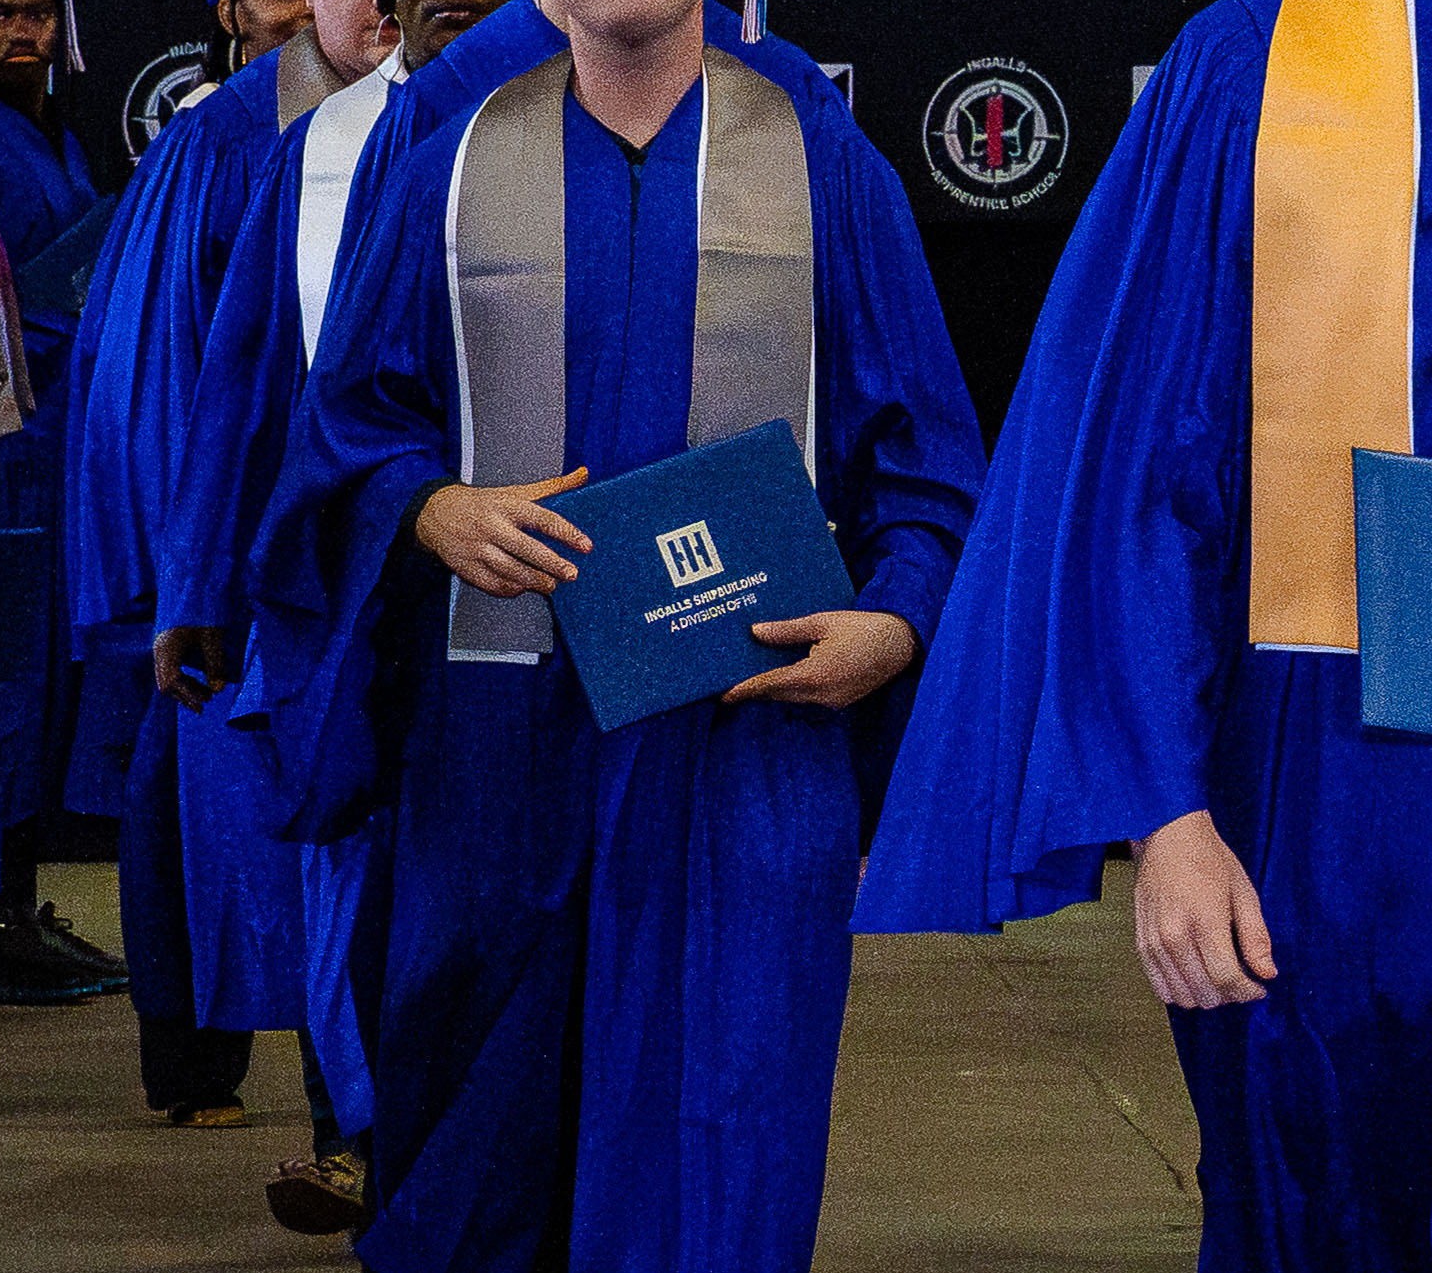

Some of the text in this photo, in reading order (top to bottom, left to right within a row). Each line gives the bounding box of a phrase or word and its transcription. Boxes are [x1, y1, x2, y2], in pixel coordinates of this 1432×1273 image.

[644, 571, 768, 623] INGALLS SHIPBUILDING
[670, 620, 680, 632] A
[679, 604, 726, 629] DIVISION
[726, 597, 743, 612] OF
